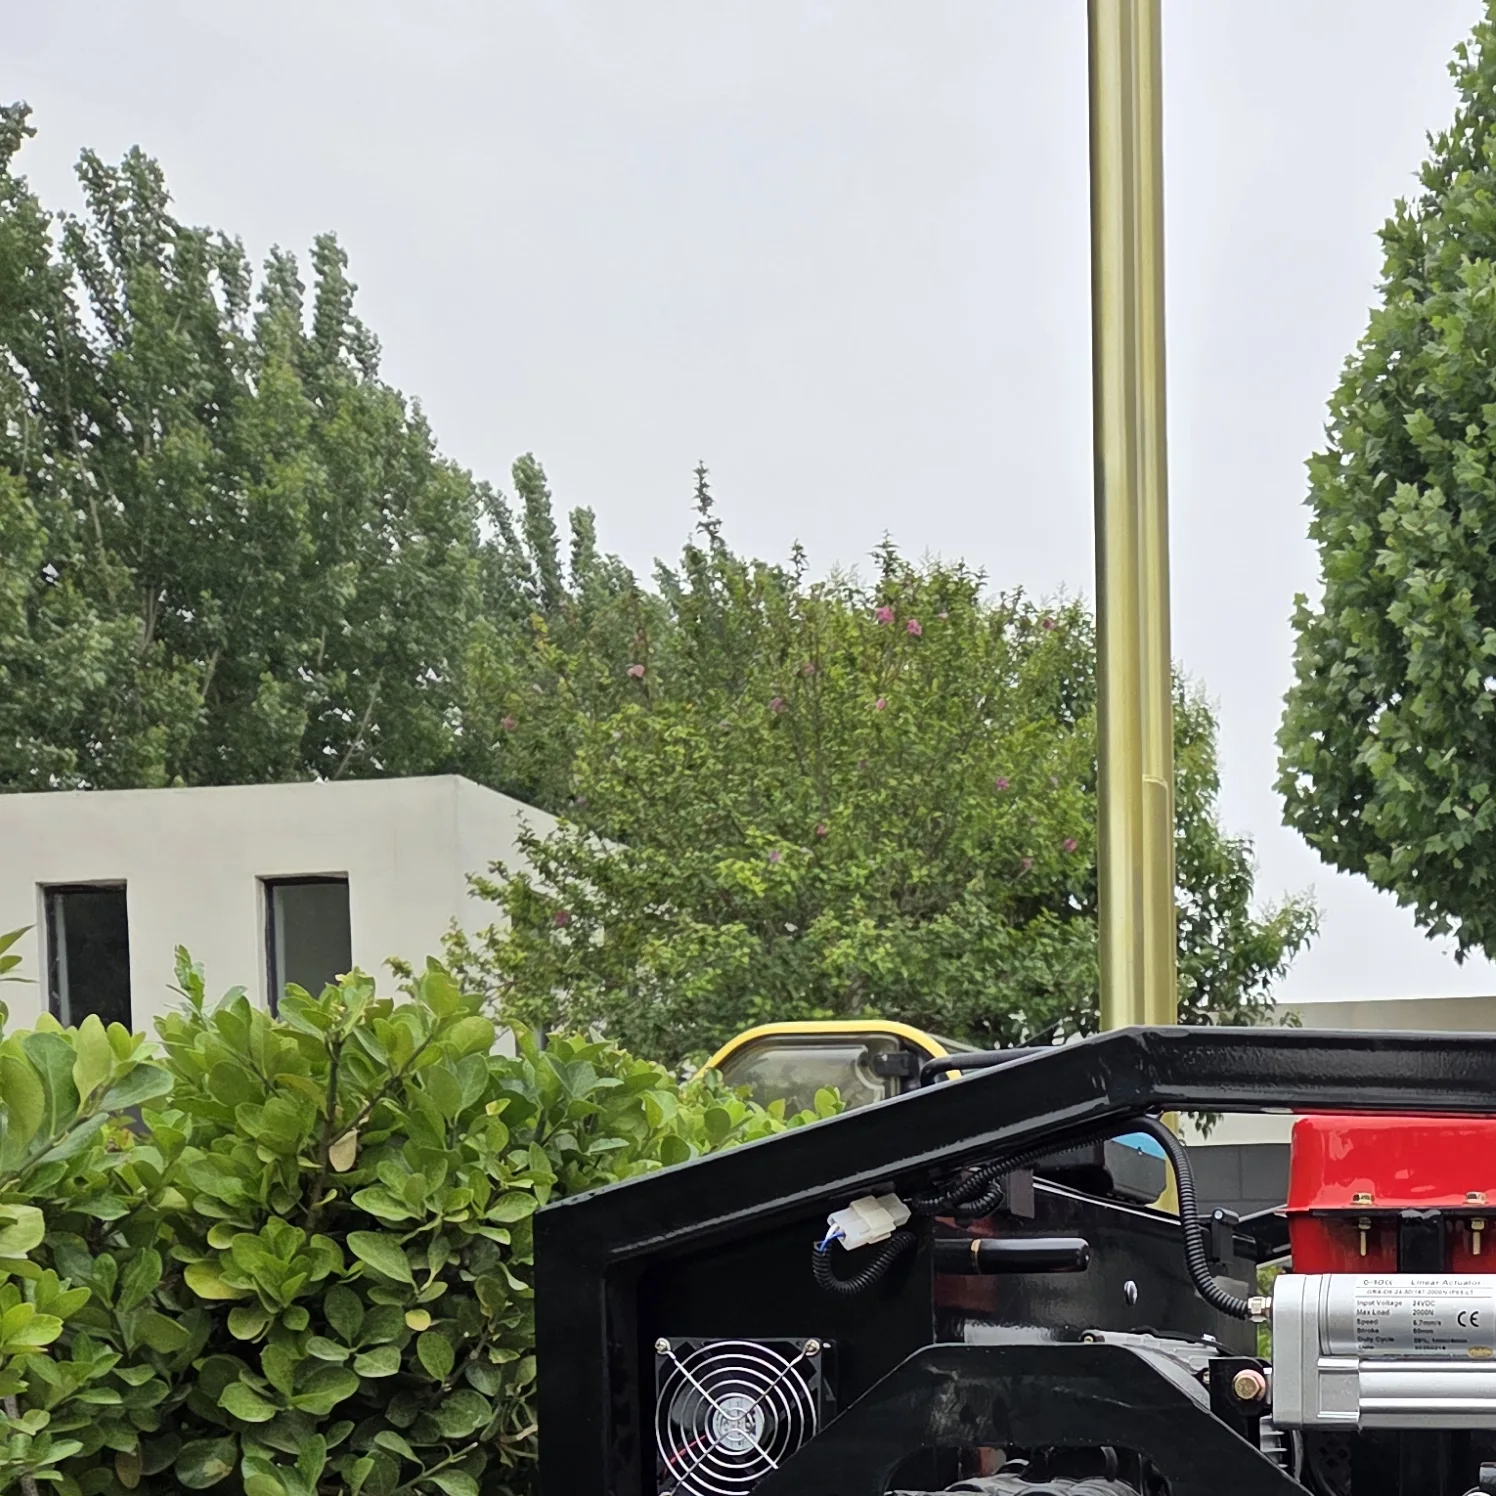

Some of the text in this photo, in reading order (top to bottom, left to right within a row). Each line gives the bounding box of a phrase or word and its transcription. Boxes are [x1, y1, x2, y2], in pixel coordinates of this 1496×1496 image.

[1357, 1300, 1402, 1308] Input Voltage
[1357, 1318, 1379, 1326] Speed
[1457, 1311, 1480, 1328] CE
